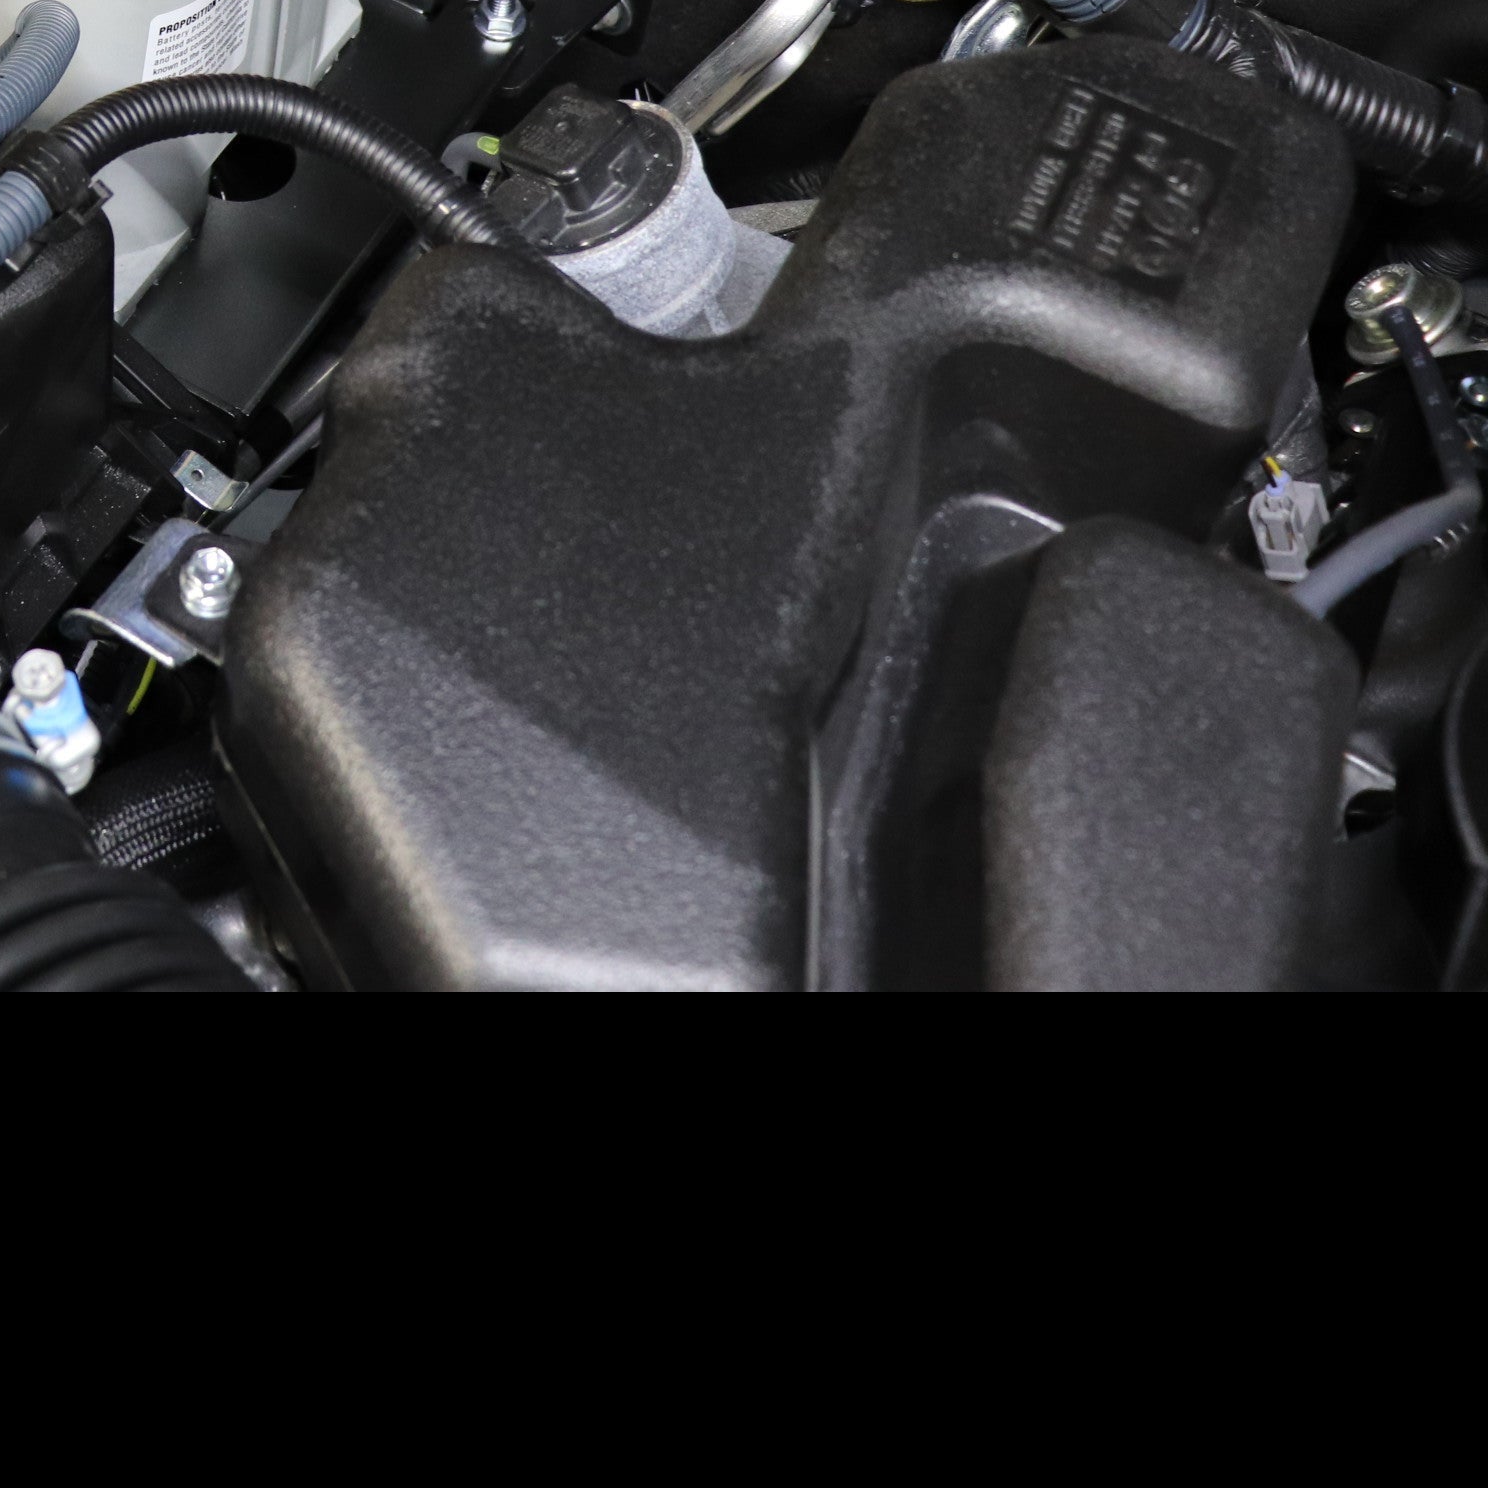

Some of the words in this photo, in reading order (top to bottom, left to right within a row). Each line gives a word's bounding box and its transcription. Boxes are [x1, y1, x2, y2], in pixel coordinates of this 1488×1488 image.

[157, 30, 190, 46] Battery
[154, 55, 170, 66] and
[172, 47, 188, 60] lead
[156, 40, 184, 56] related
[153, 61, 179, 75] known
[180, 57, 188, 66] to
